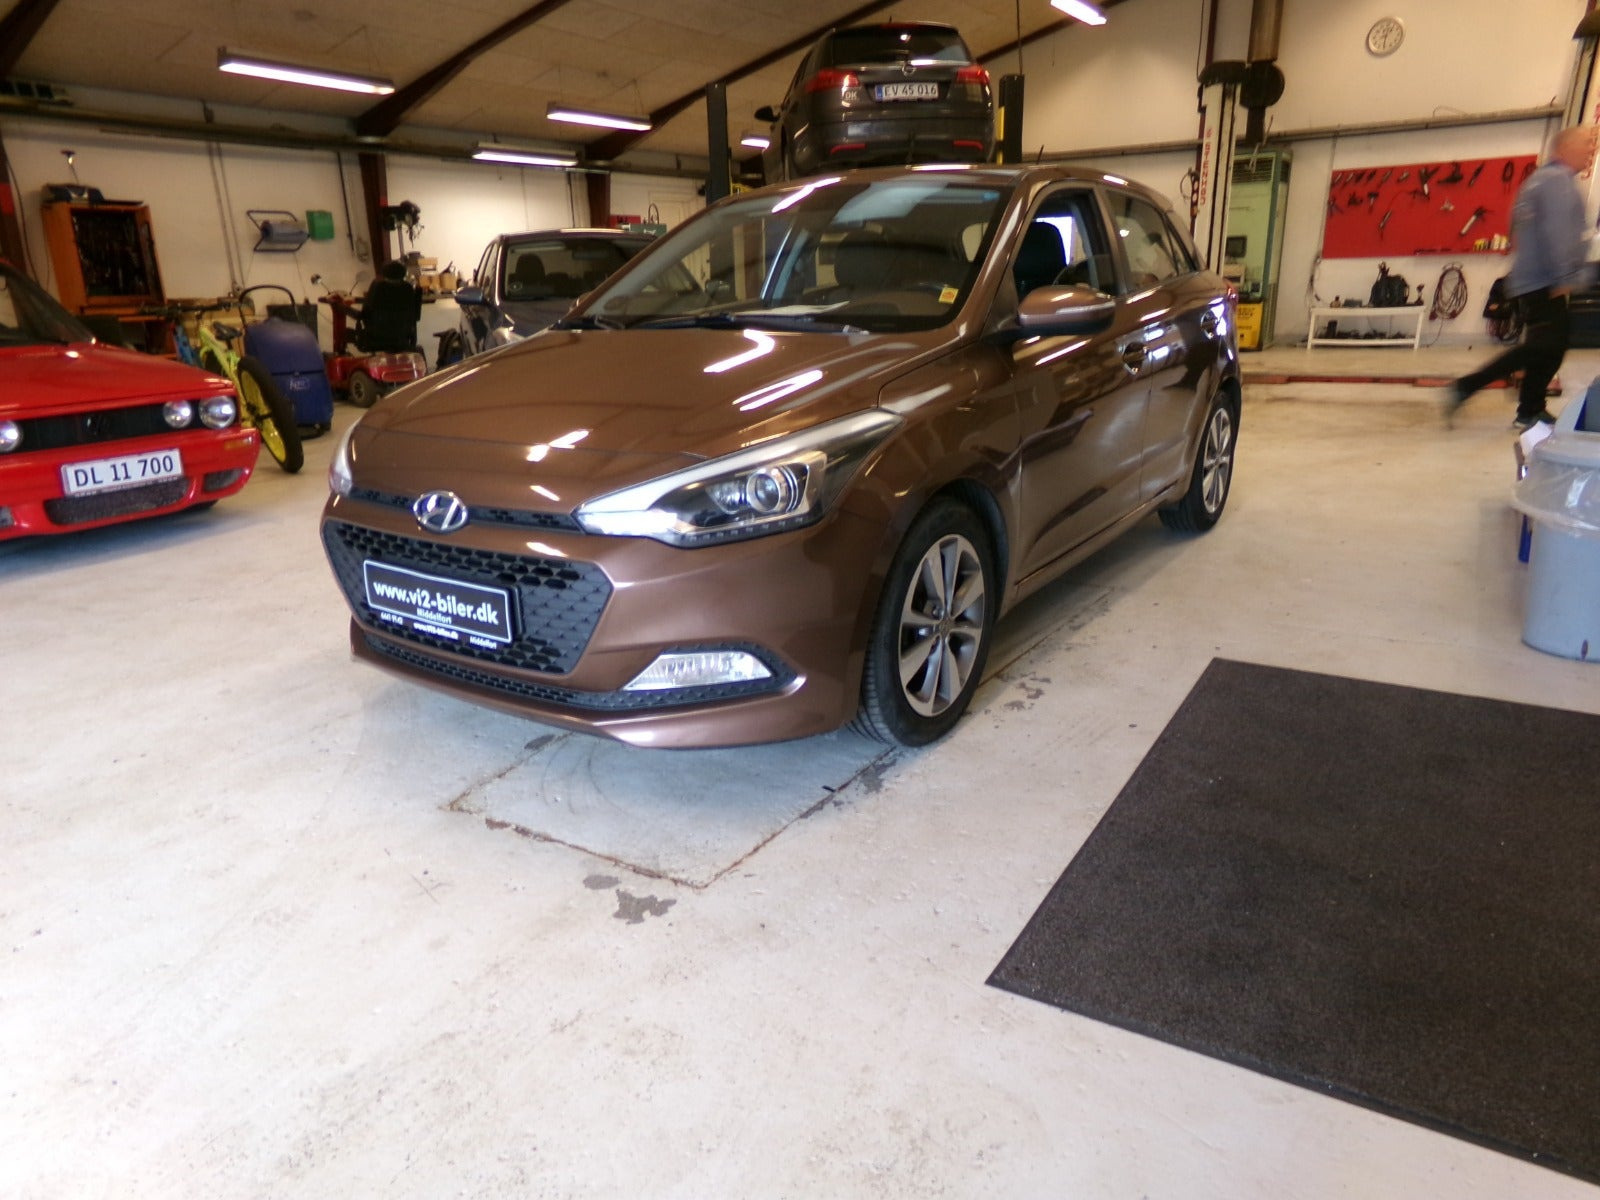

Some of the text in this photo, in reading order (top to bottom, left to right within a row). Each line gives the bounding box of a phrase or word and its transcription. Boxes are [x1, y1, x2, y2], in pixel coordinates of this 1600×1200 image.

[902, 84, 914, 96] 45
[917, 83, 937, 96] 016
[74, 467, 103, 487] DL
[110, 462, 131, 482] 11
[137, 455, 174, 476] 700
[374, 582, 499, 624] www.vi2-biler.dk
